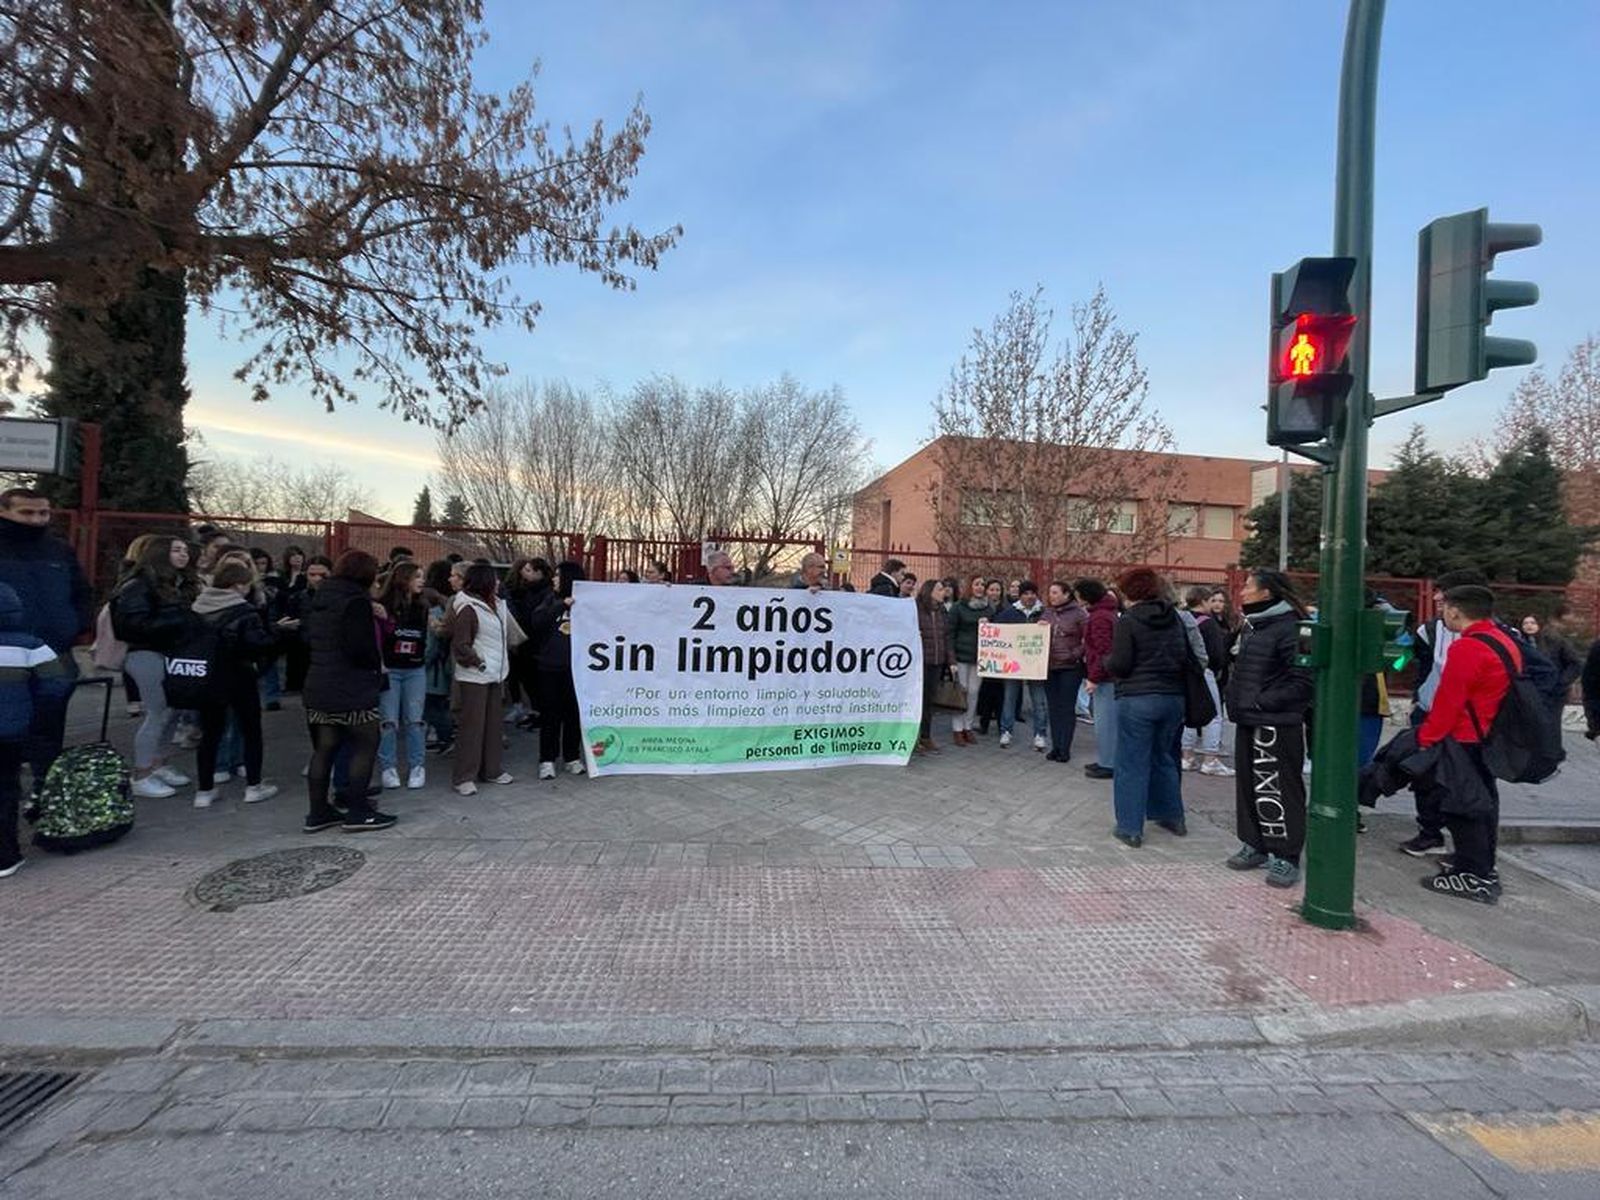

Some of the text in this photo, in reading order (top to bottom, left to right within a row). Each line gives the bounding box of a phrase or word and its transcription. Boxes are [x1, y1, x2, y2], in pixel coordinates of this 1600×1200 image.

[692, 596, 834, 634] 2 años
[980, 625, 1000, 638] SIN
[164, 656, 207, 677] VANS
[587, 636, 913, 681] sin limpiador@
[668, 689, 687, 700] un
[694, 687, 749, 700] entorno
[756, 688, 797, 702] limpio
[803, 690, 810, 701] y
[668, 704, 699, 717] más
[707, 704, 765, 718] limpieza
[773, 705, 789, 717] en
[796, 703, 843, 714] nuestro
[793, 726, 866, 740] EXIGIMOS
[745, 740, 907, 759] personal de limpieza YA
[1252, 725, 1288, 840] DANCE
